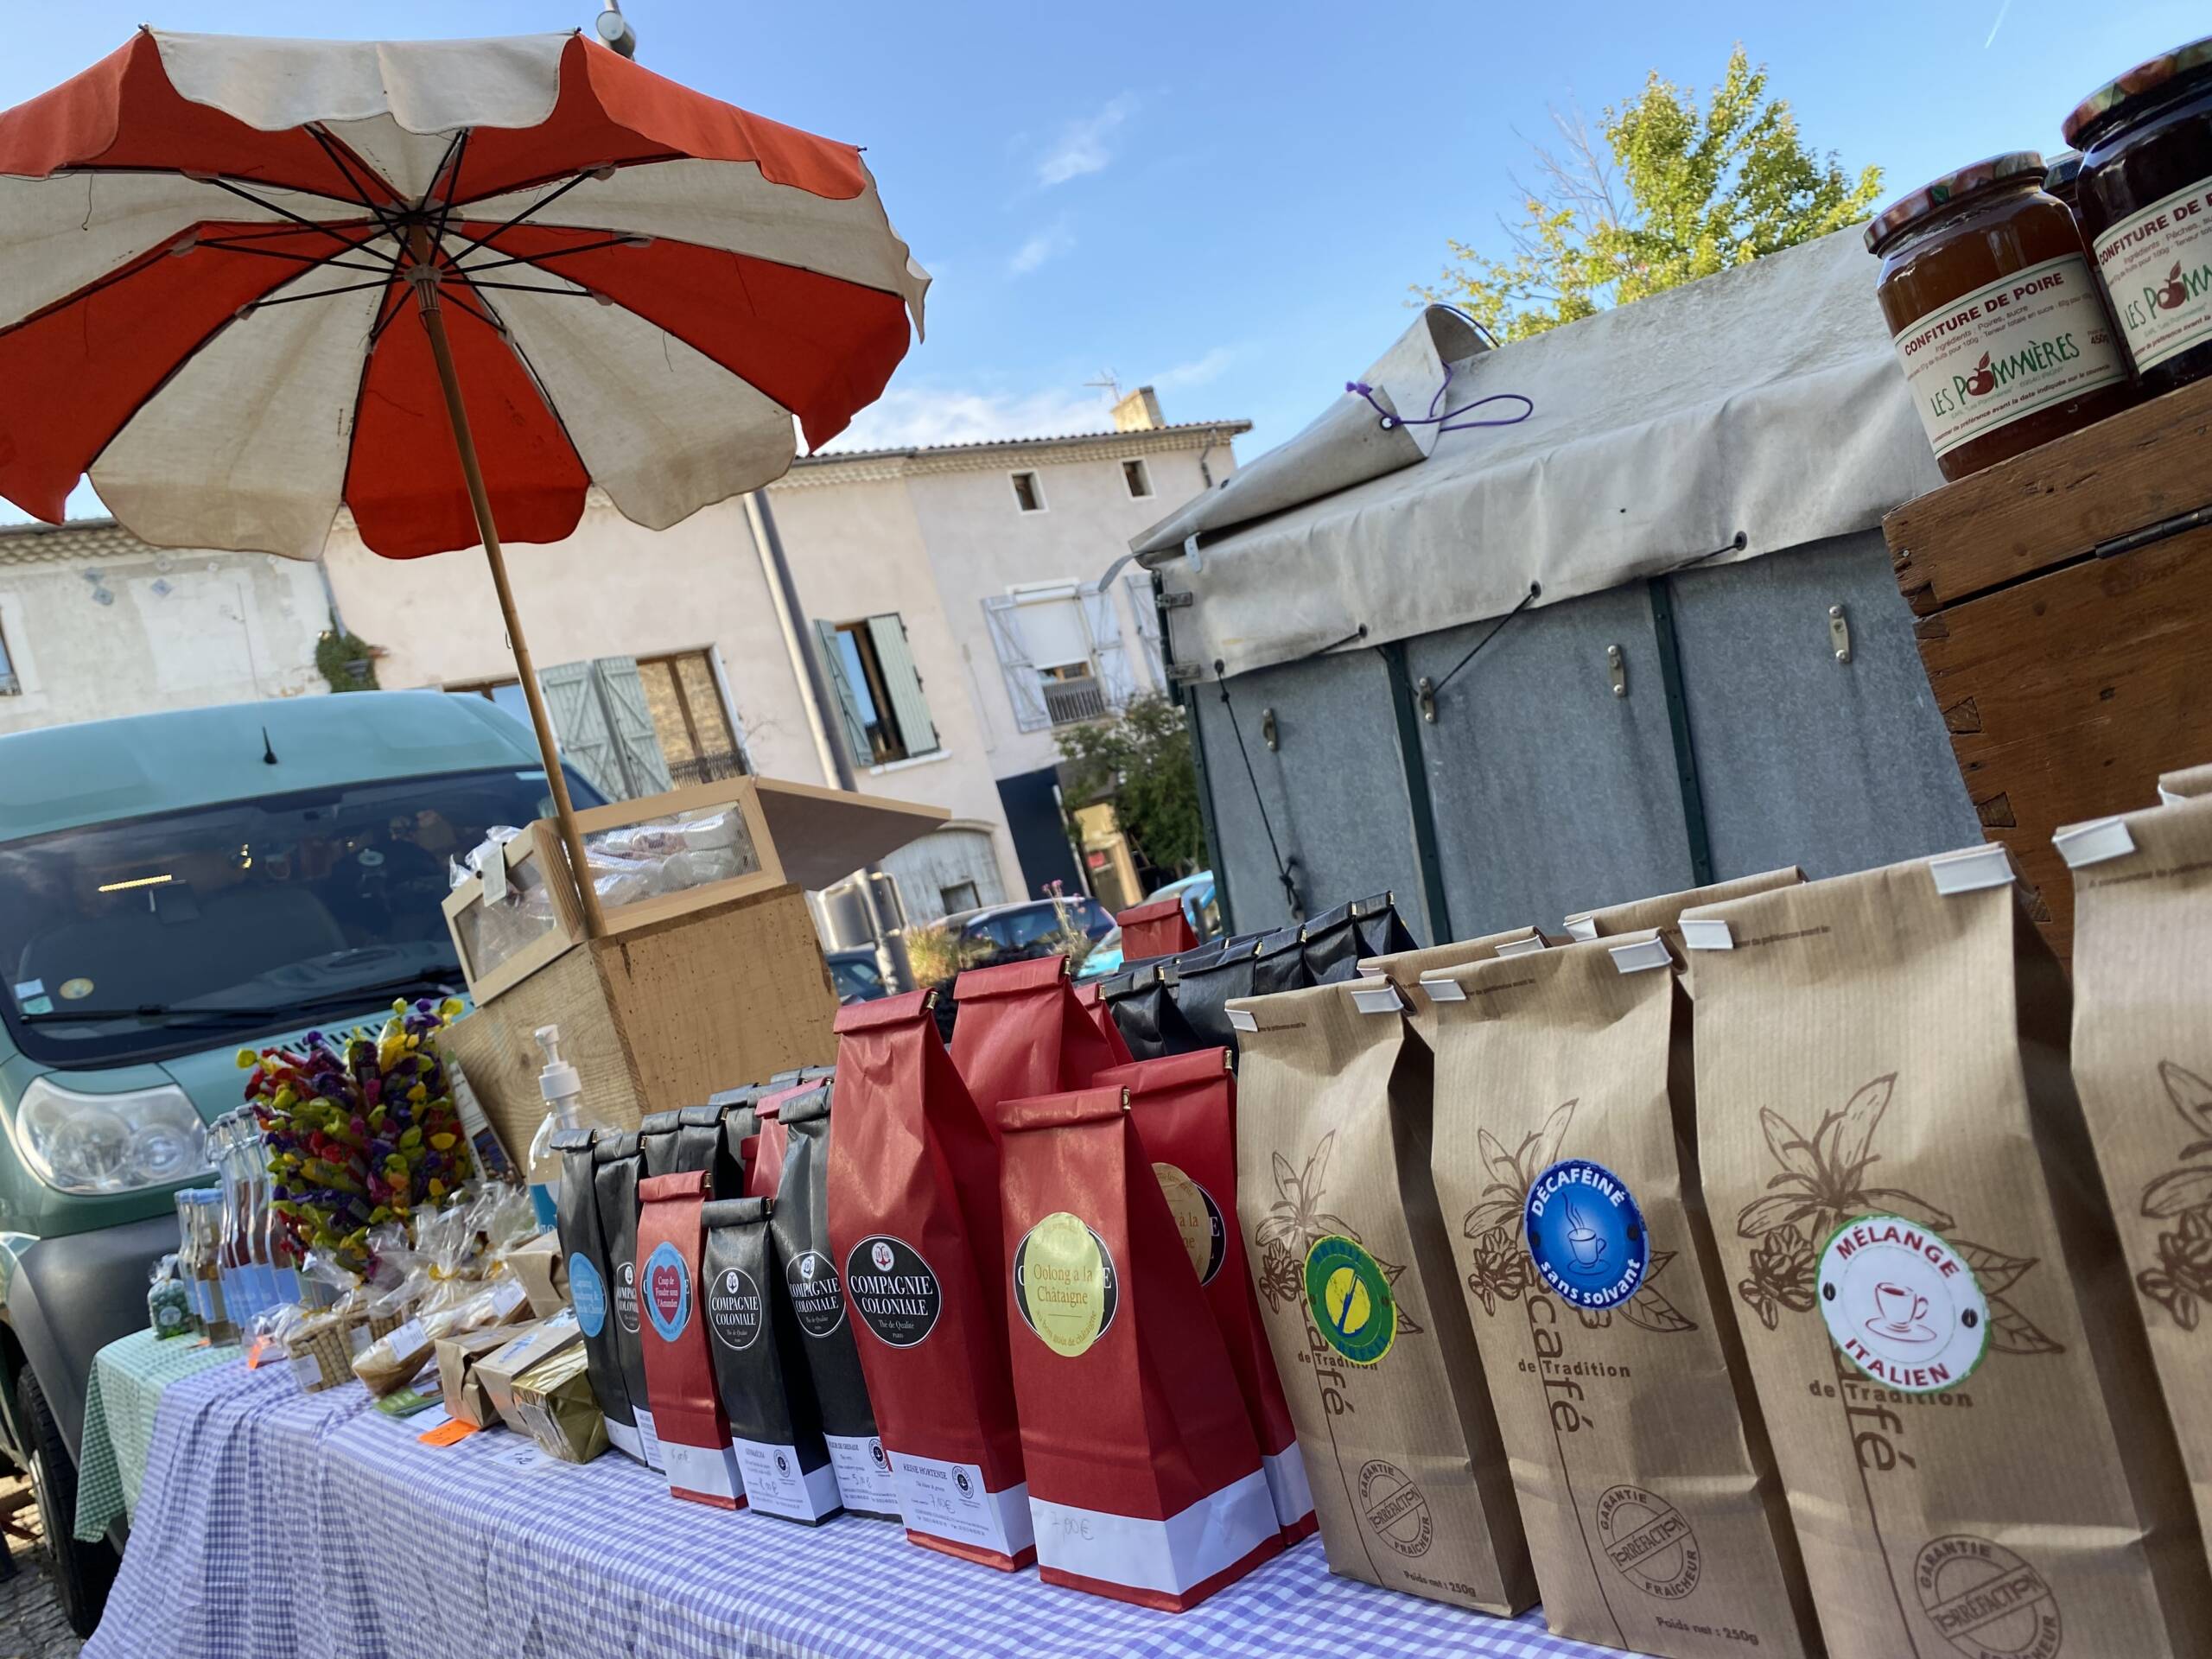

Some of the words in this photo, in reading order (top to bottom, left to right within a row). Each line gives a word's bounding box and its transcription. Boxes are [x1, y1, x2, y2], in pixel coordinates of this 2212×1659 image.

[2099, 214, 2170, 266] CONFITURE
[2172, 200, 2202, 222] DE
[1904, 306, 1982, 356] CONFITURE
[1984, 293, 2011, 314] DE
[2012, 272, 2065, 302] POIRE
[2125, 300, 2146, 331] LES
[1929, 388, 1955, 417] LES
[1960, 410, 1992, 430] préférence
[1992, 400, 2012, 414] avant
[2019, 391, 2036, 401] date
[1531, 1166, 1625, 1218] DÉCAFÉINÉ
[1189, 1211, 1199, 1227] la
[1835, 1224, 1961, 1279] MÉLANGE
[658, 1275, 669, 1287] Coup
[669, 1275, 675, 1285] de
[789, 1276, 842, 1299] COMPAGNIE
[850, 1274, 933, 1295] COMPAGNIE
[1033, 1263, 1071, 1286] Oolong
[1082, 1265, 1093, 1283] la
[1541, 1259, 1580, 1301] sans
[1582, 1257, 1642, 1306] solvant
[711, 1295, 759, 1311] COMPAGNIE
[794, 1295, 840, 1314] COLONIALE
[861, 1297, 929, 1316] COLONIALE
[1037, 1284, 1089, 1308] Châtaigne
[715, 1313, 757, 1326] COLONIALE
[1298, 1351, 1312, 1363] de
[1518, 1358, 1536, 1373] de
[1542, 1360, 1631, 1378] Tradition
[1527, 1295, 1595, 1433] café
[1845, 1338, 1952, 1387] ITALIEN
[1808, 1380, 1836, 1399] de
[1361, 1463, 1395, 1498] GARANTIE
[1369, 1485, 1421, 1529] TORRÉFACTION
[1600, 1489, 1648, 1531] GARANTIE
[1394, 1516, 1430, 1555] FRAÎCHEUR
[1610, 1513, 1686, 1567] TORRÉFACTION
[1645, 1549, 1698, 1598] FRAÎCHEUR
[1920, 1540, 1992, 1590] GARANTIE
[1449, 1581, 1477, 1599] 250g
[1932, 1571, 2044, 1632] TORRÉFACTION
[1655, 1616, 1690, 1631] Poids
[1692, 1623, 1713, 1636] net
[1722, 1626, 1760, 1646] 250g
